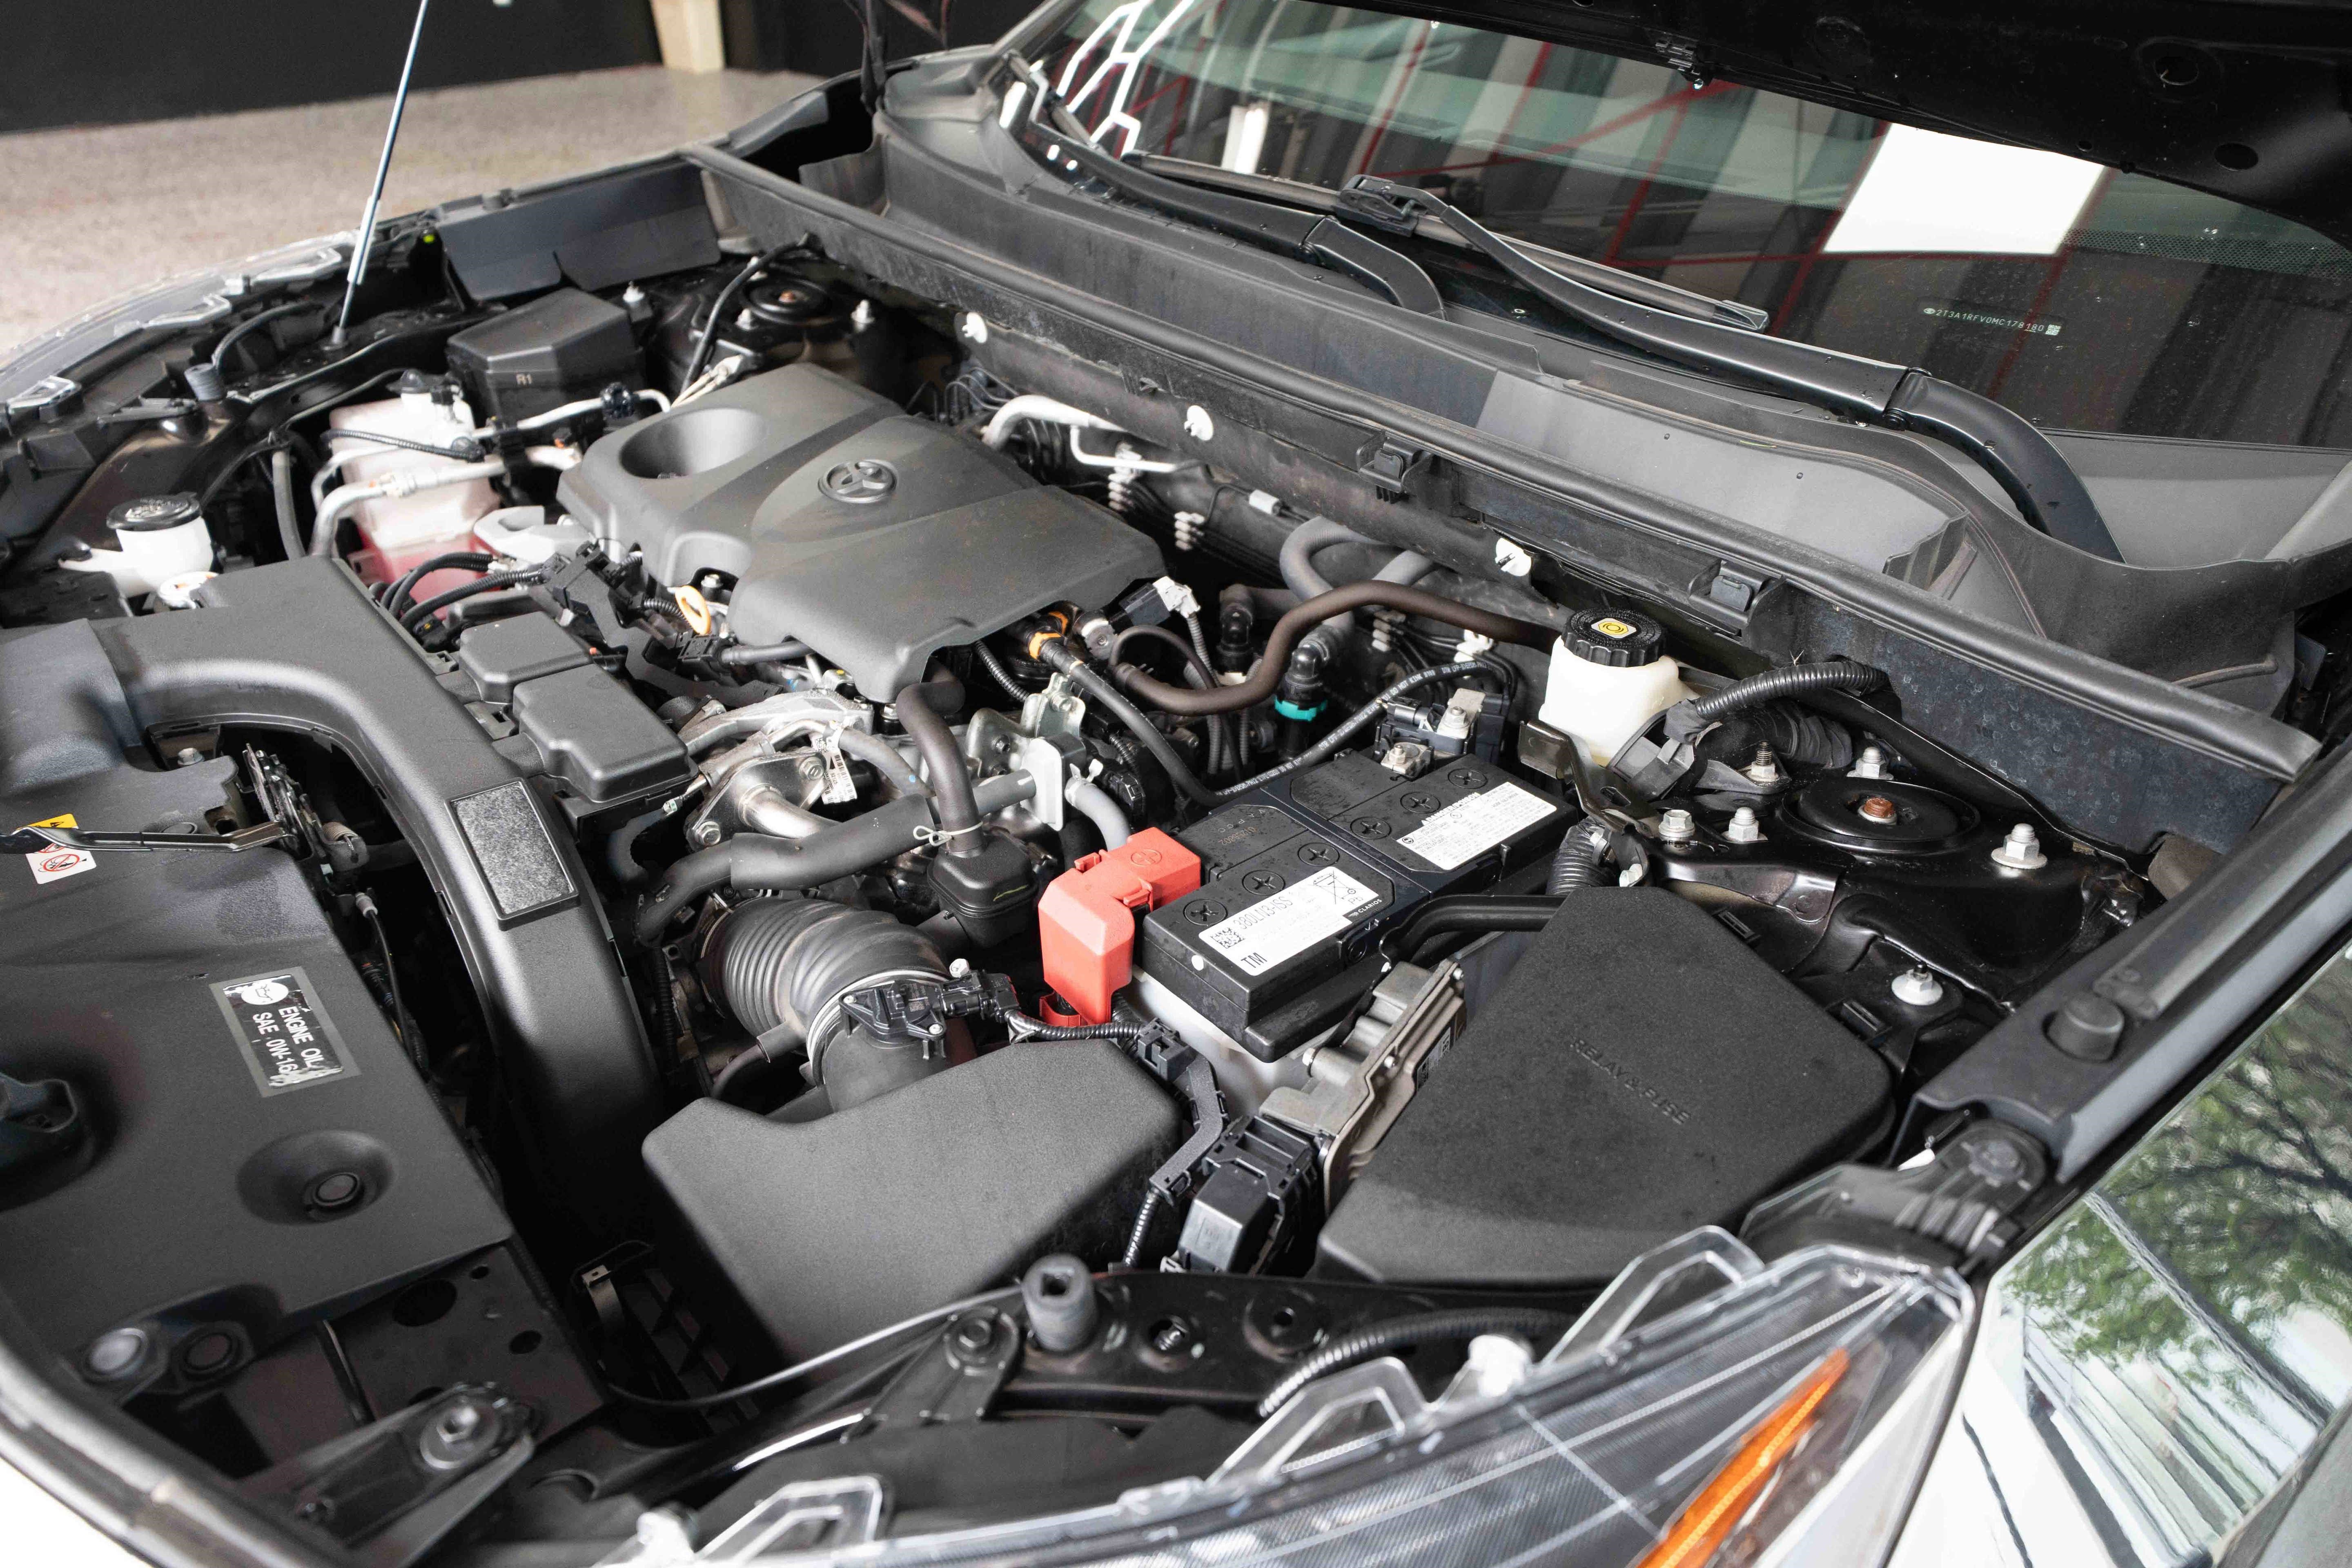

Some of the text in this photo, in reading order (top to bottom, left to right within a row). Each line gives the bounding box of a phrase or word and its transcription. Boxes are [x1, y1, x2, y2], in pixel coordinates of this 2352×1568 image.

[1358, 899, 1383, 913] CLARIOS
[1241, 952, 1267, 969] TM
[252, 1012, 298, 1075] SAE 0W-16
[278, 1006, 325, 1068] ENGINE OIL
